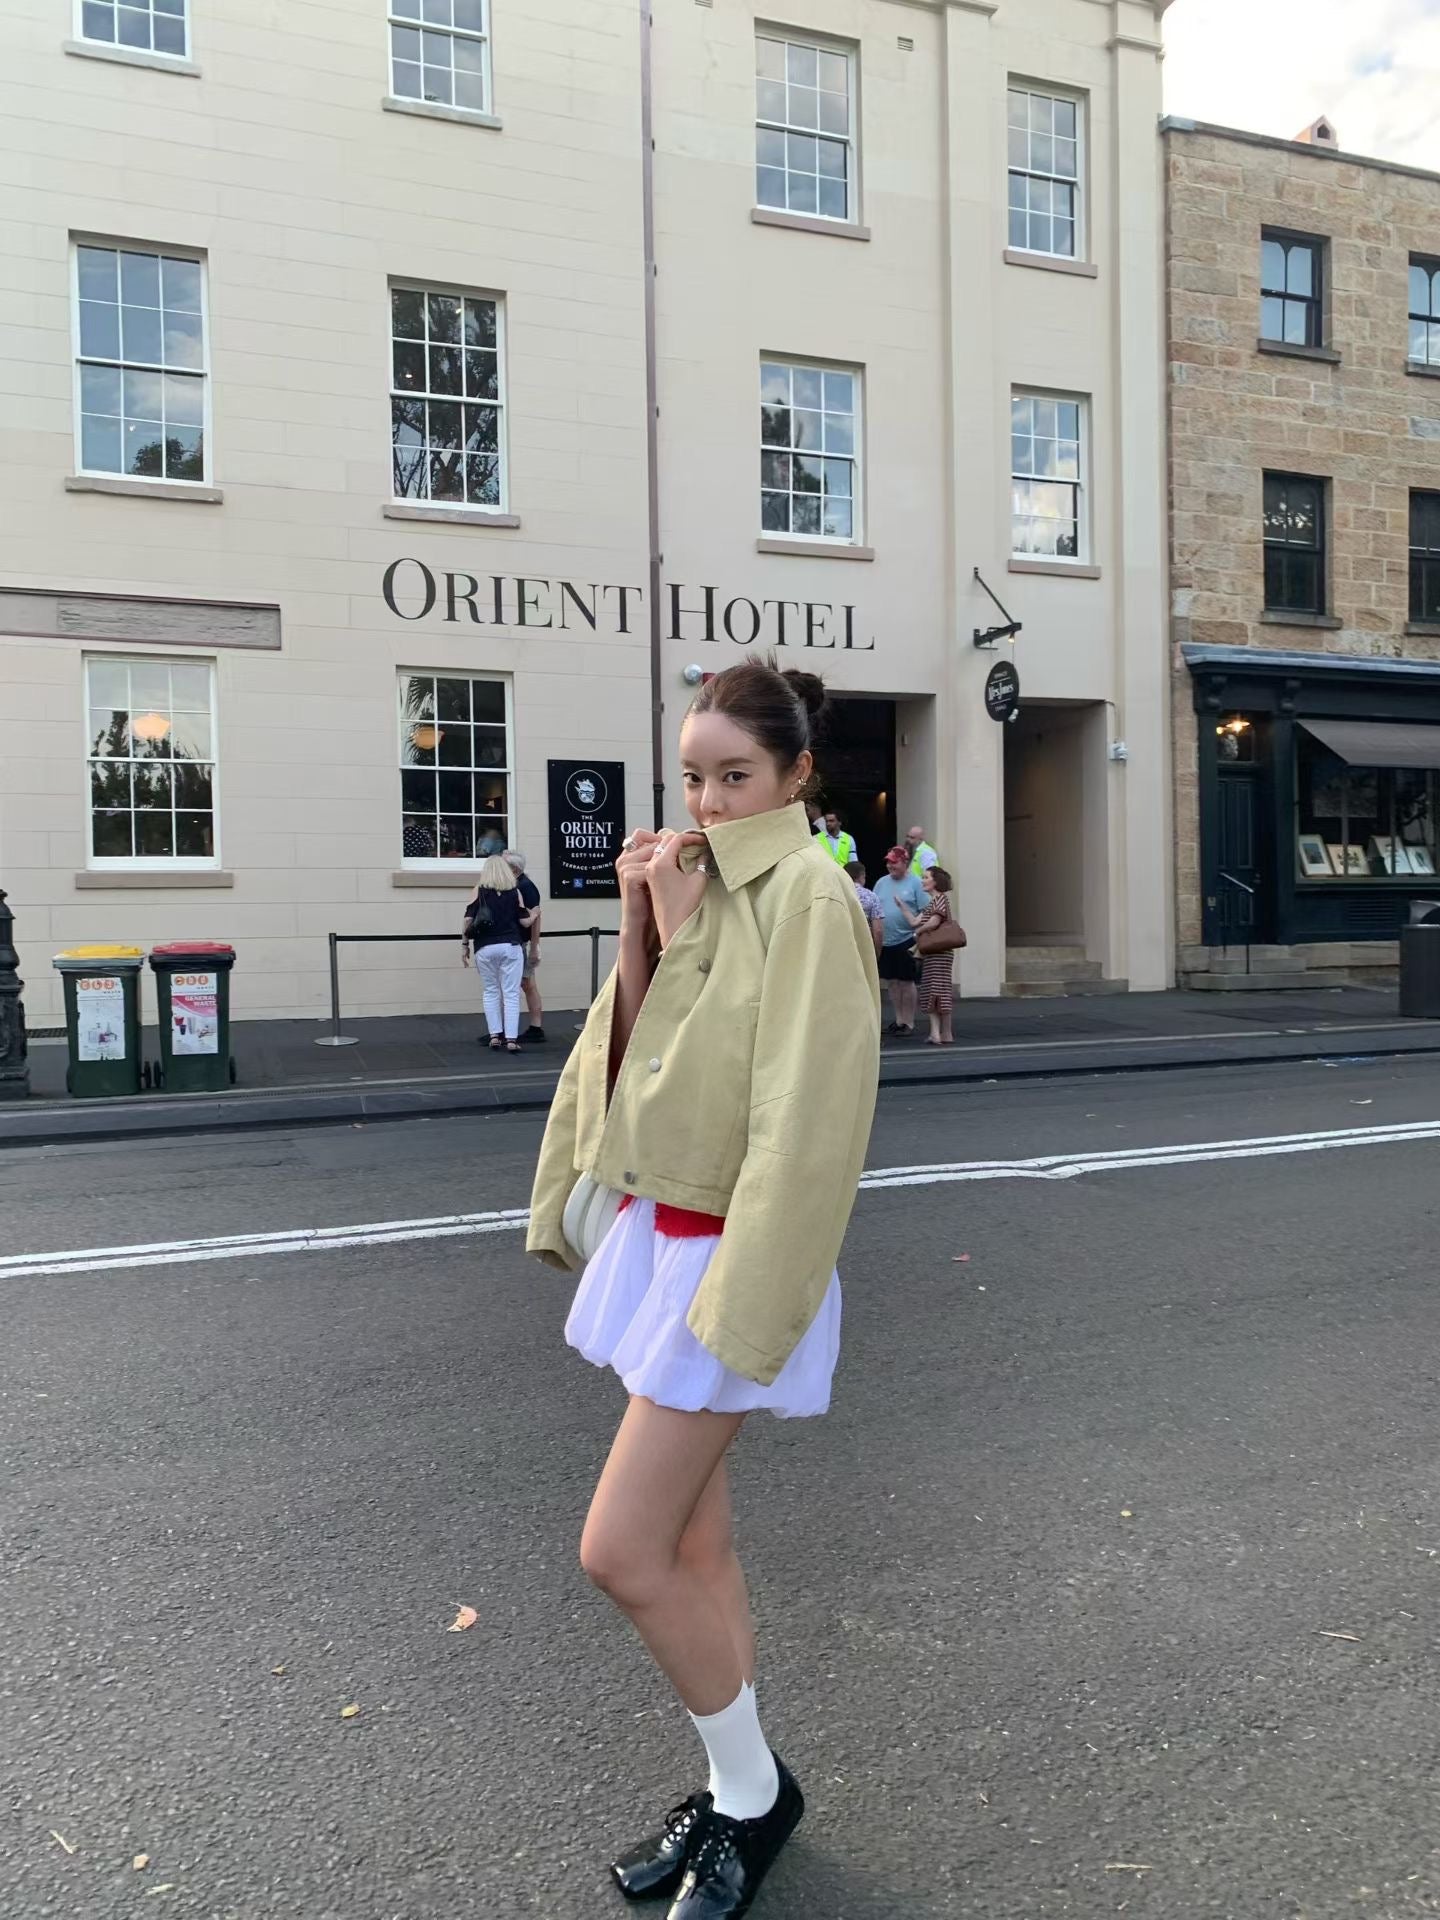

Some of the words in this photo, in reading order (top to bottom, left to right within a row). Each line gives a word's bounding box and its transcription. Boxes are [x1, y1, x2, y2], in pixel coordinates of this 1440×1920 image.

[382, 557, 643, 634] ORIENT
[665, 582, 877, 651] HOTEL
[560, 822, 614, 835] ORIENT
[565, 835, 611, 849] HOTEL
[562, 862, 588, 870] TERRACE
[592, 862, 613, 870] DINING
